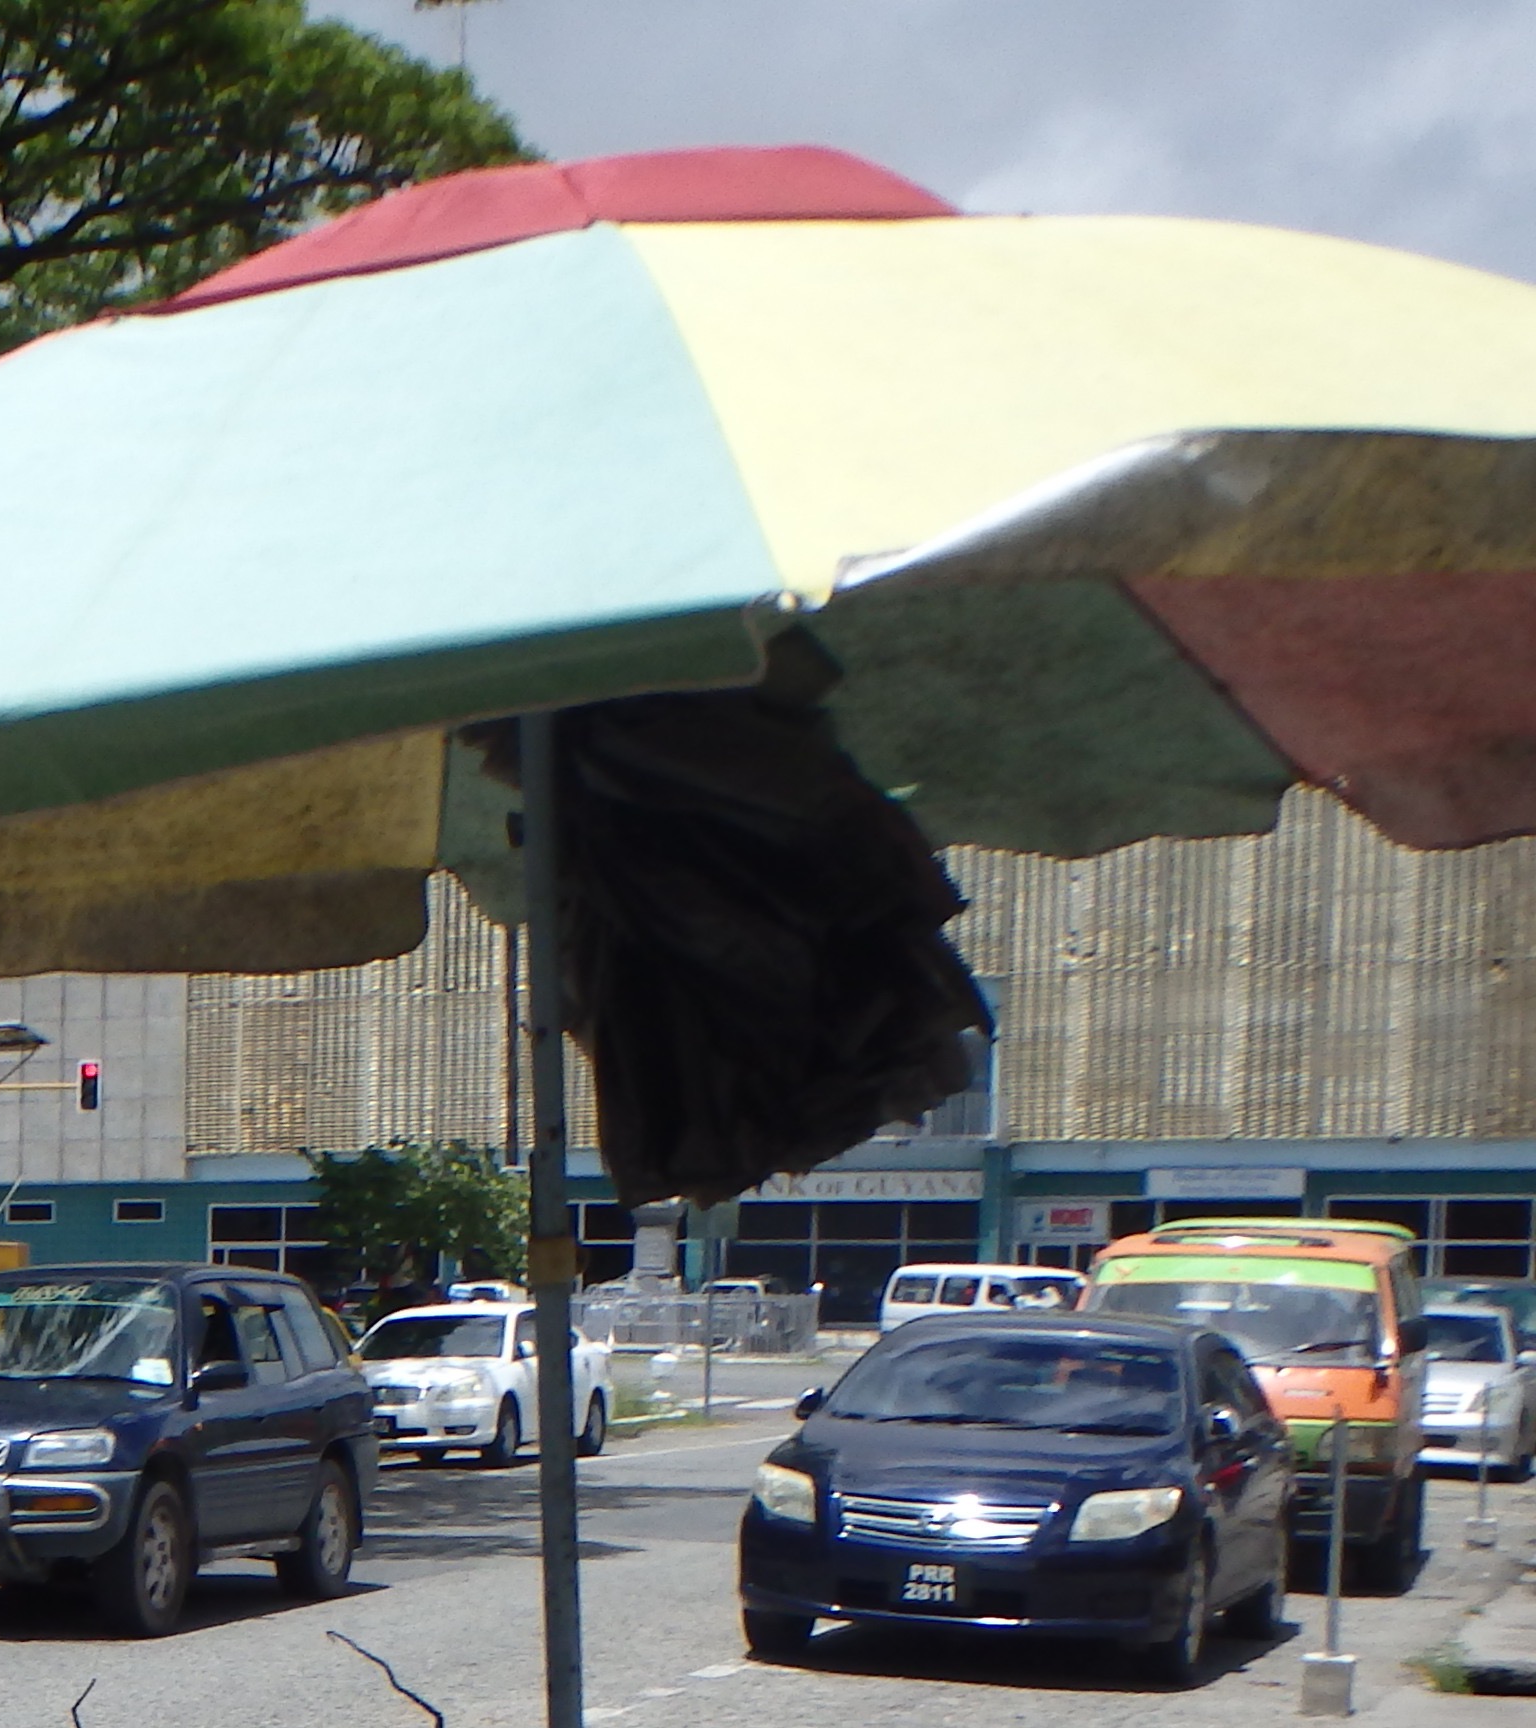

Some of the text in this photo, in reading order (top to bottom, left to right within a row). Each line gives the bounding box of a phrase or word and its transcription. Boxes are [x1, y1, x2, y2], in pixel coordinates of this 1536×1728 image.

[855, 1175, 982, 1196] GUYANA
[908, 1563, 956, 1583] PRR
[902, 1582, 957, 1602] 2811
